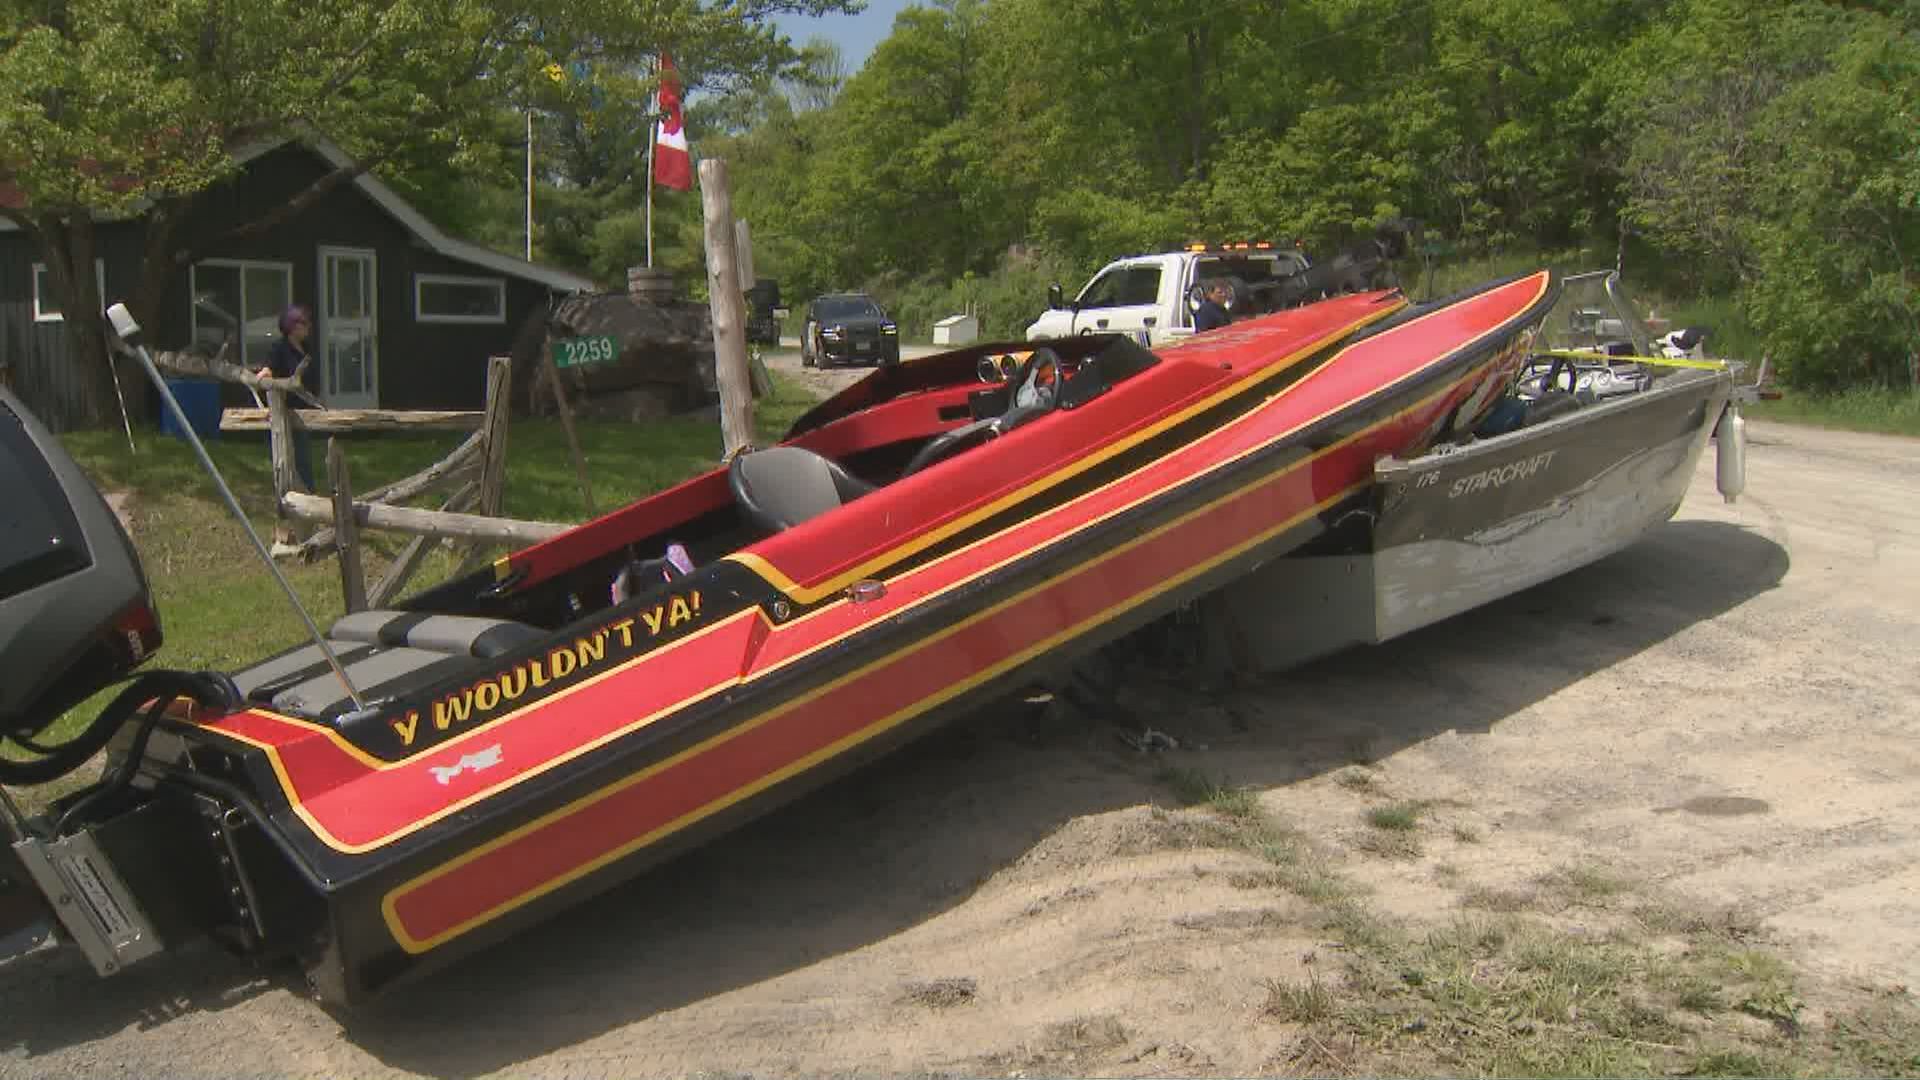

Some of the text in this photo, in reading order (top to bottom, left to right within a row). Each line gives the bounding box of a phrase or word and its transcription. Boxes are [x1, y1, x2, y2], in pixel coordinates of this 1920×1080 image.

[565, 338, 612, 365] 2259
[1449, 450, 1556, 498] STARCRAFT
[391, 590, 702, 746] Y WOULDN'T YA!
